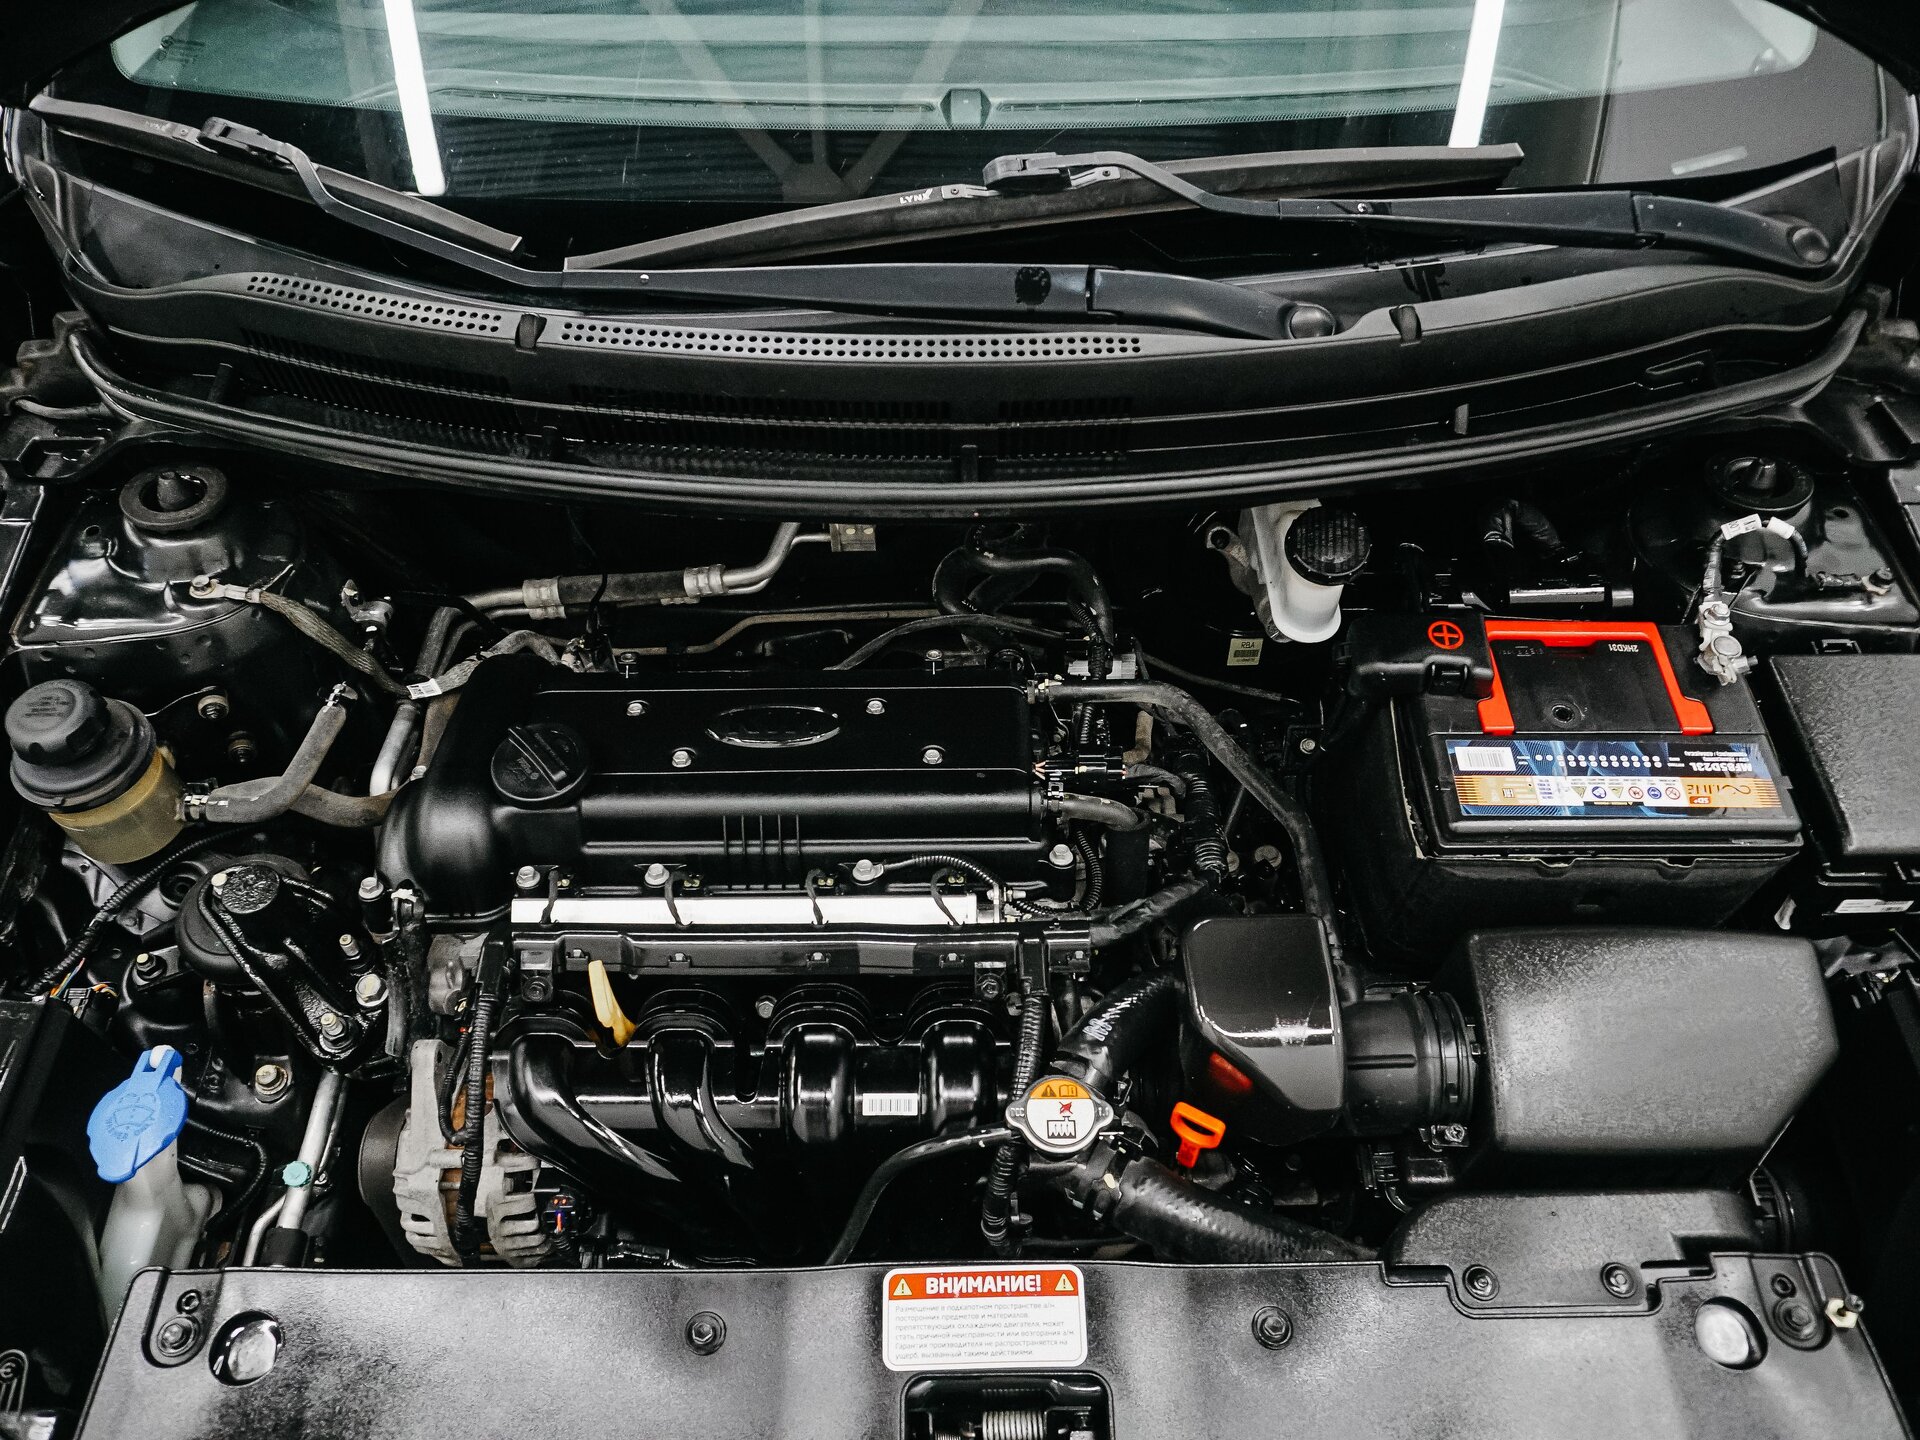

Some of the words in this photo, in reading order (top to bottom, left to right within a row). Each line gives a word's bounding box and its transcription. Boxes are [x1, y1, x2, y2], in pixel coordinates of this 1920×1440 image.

[899, 188, 933, 204] LYNX
[1688, 762, 1753, 772] MF85D23L
[925, 1274, 1042, 1294] ВНИМАНИЕ!
